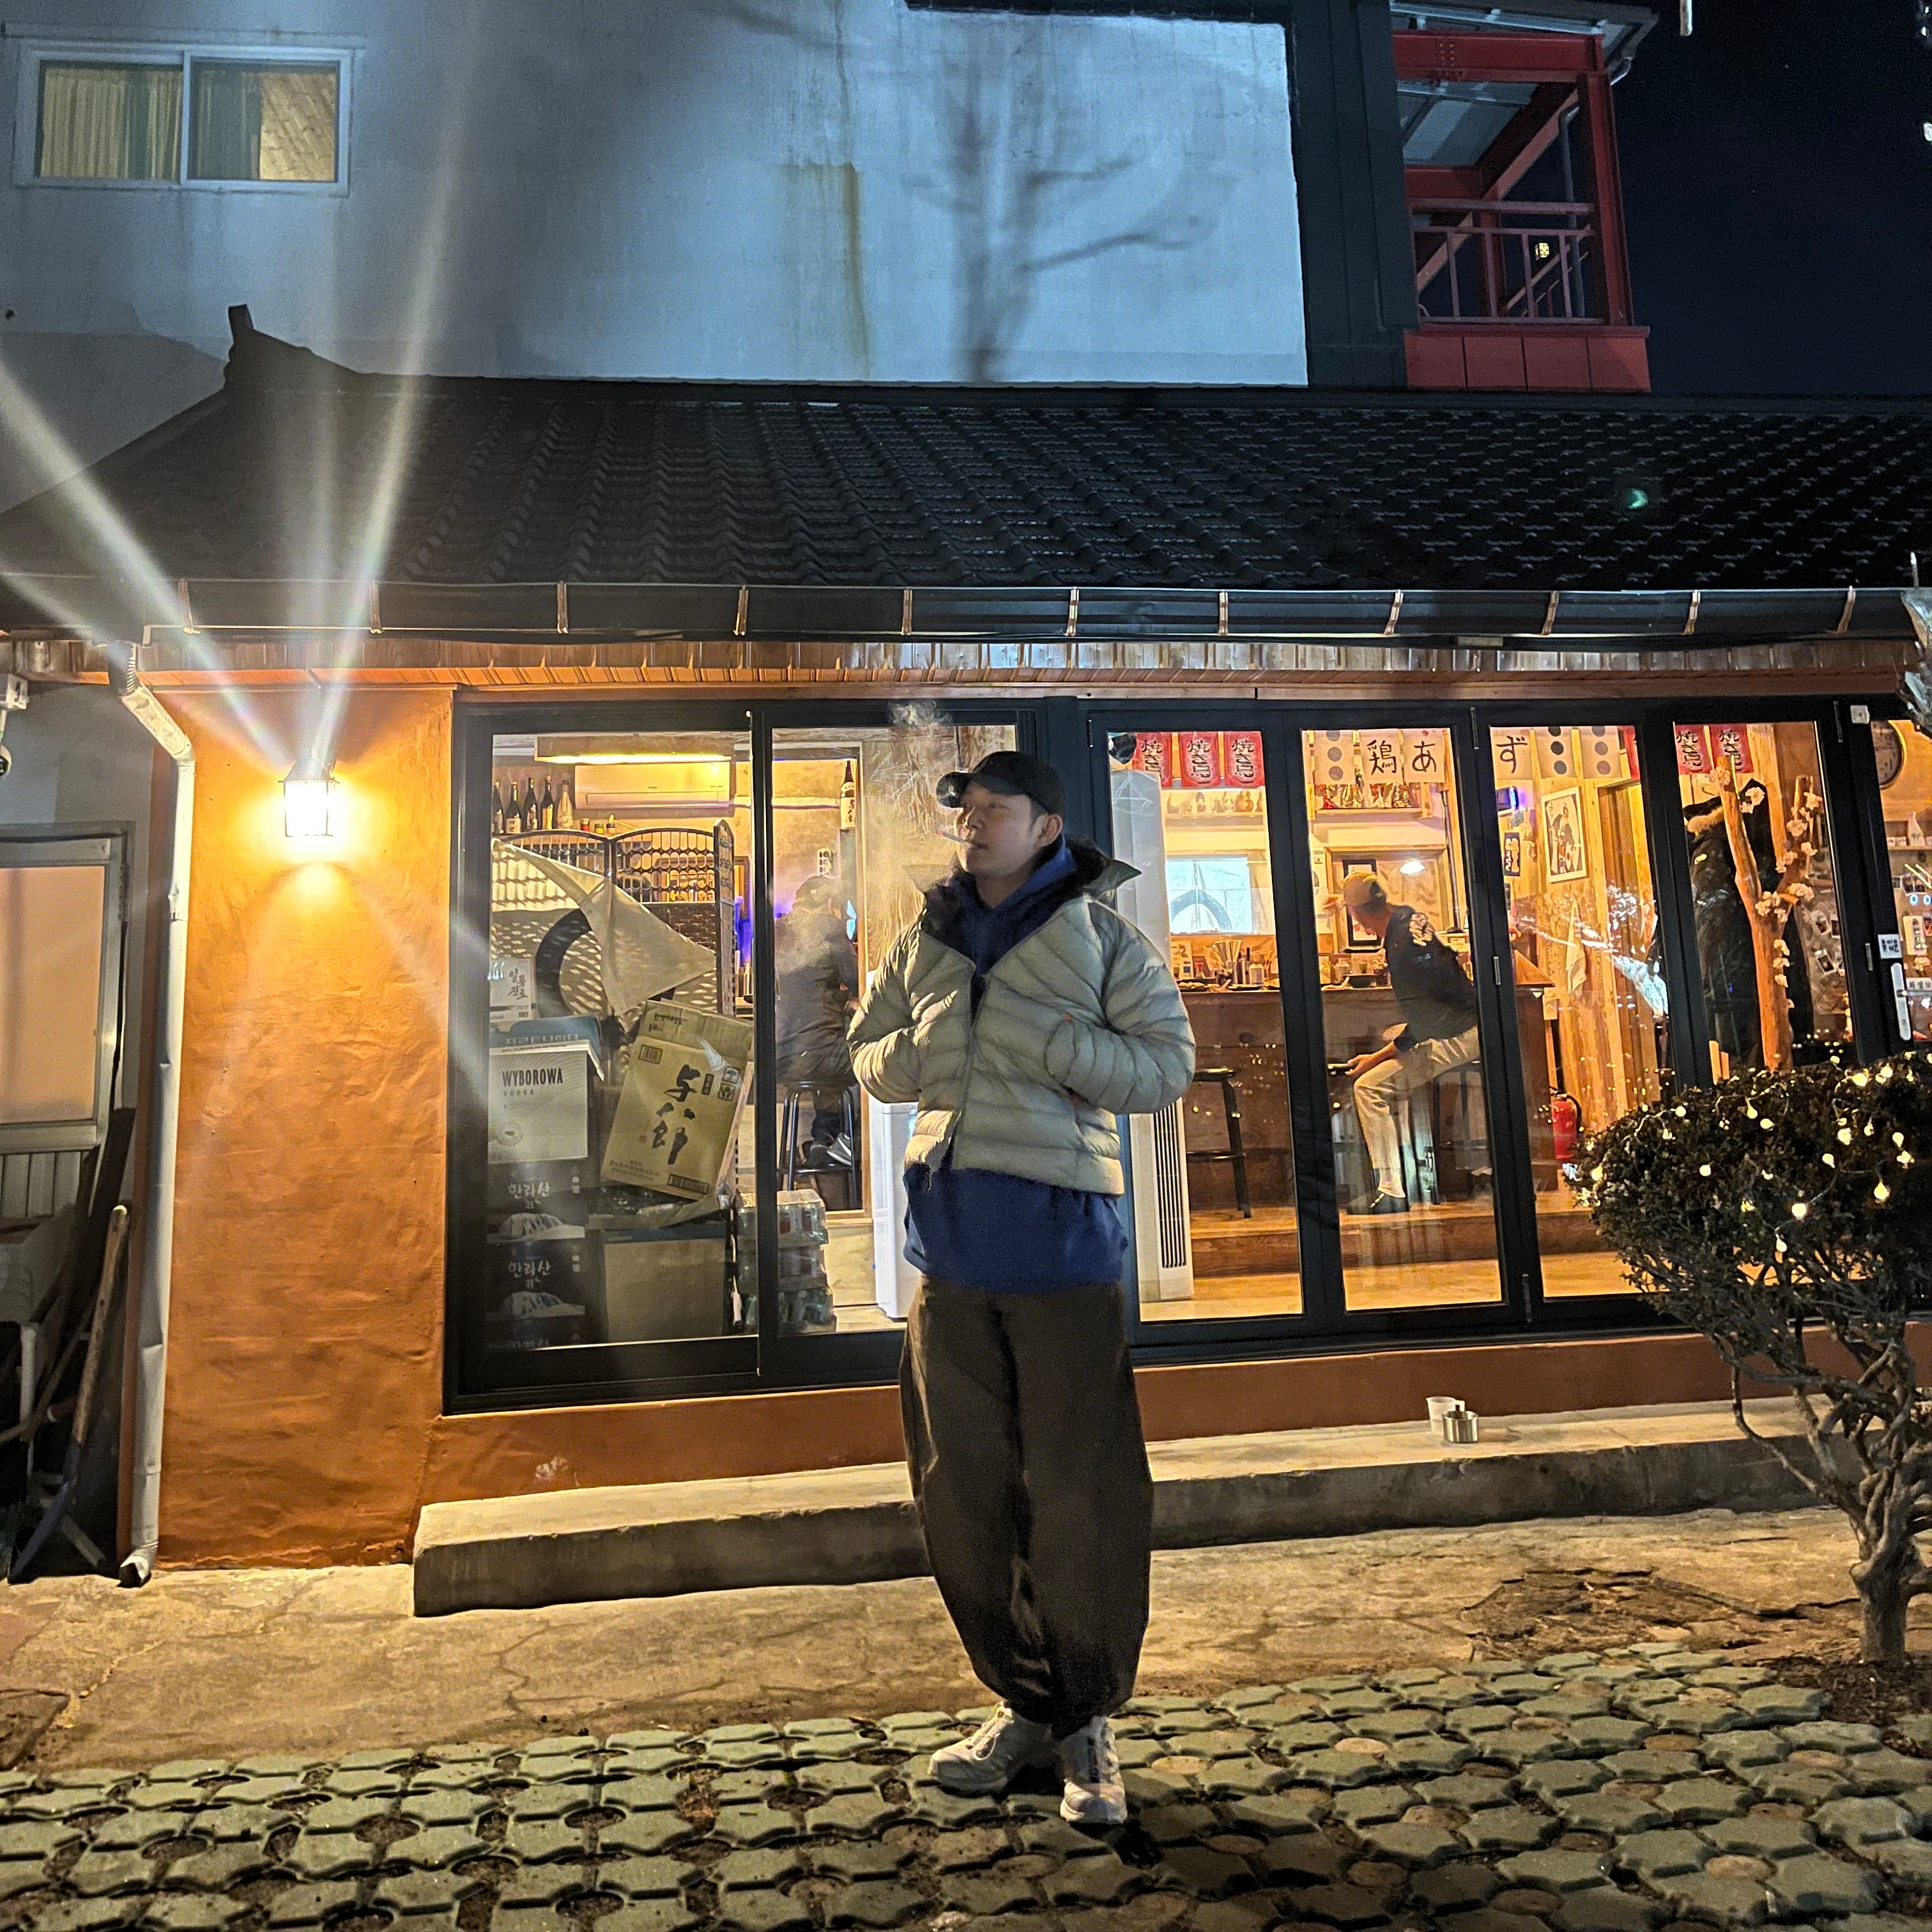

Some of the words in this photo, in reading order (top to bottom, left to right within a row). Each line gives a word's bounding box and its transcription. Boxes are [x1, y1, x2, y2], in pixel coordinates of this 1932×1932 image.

[1187, 739, 1211, 778] 焼き鳥
[1231, 739, 1255, 778] 焼き鳥
[1496, 735, 1528, 773] ず
[1676, 731, 1702, 767] 焼き鳥
[502, 1068, 564, 1086] WYBOROWA
[509, 1181, 551, 1199] 한라산
[509, 1260, 551, 1278] 한라산
